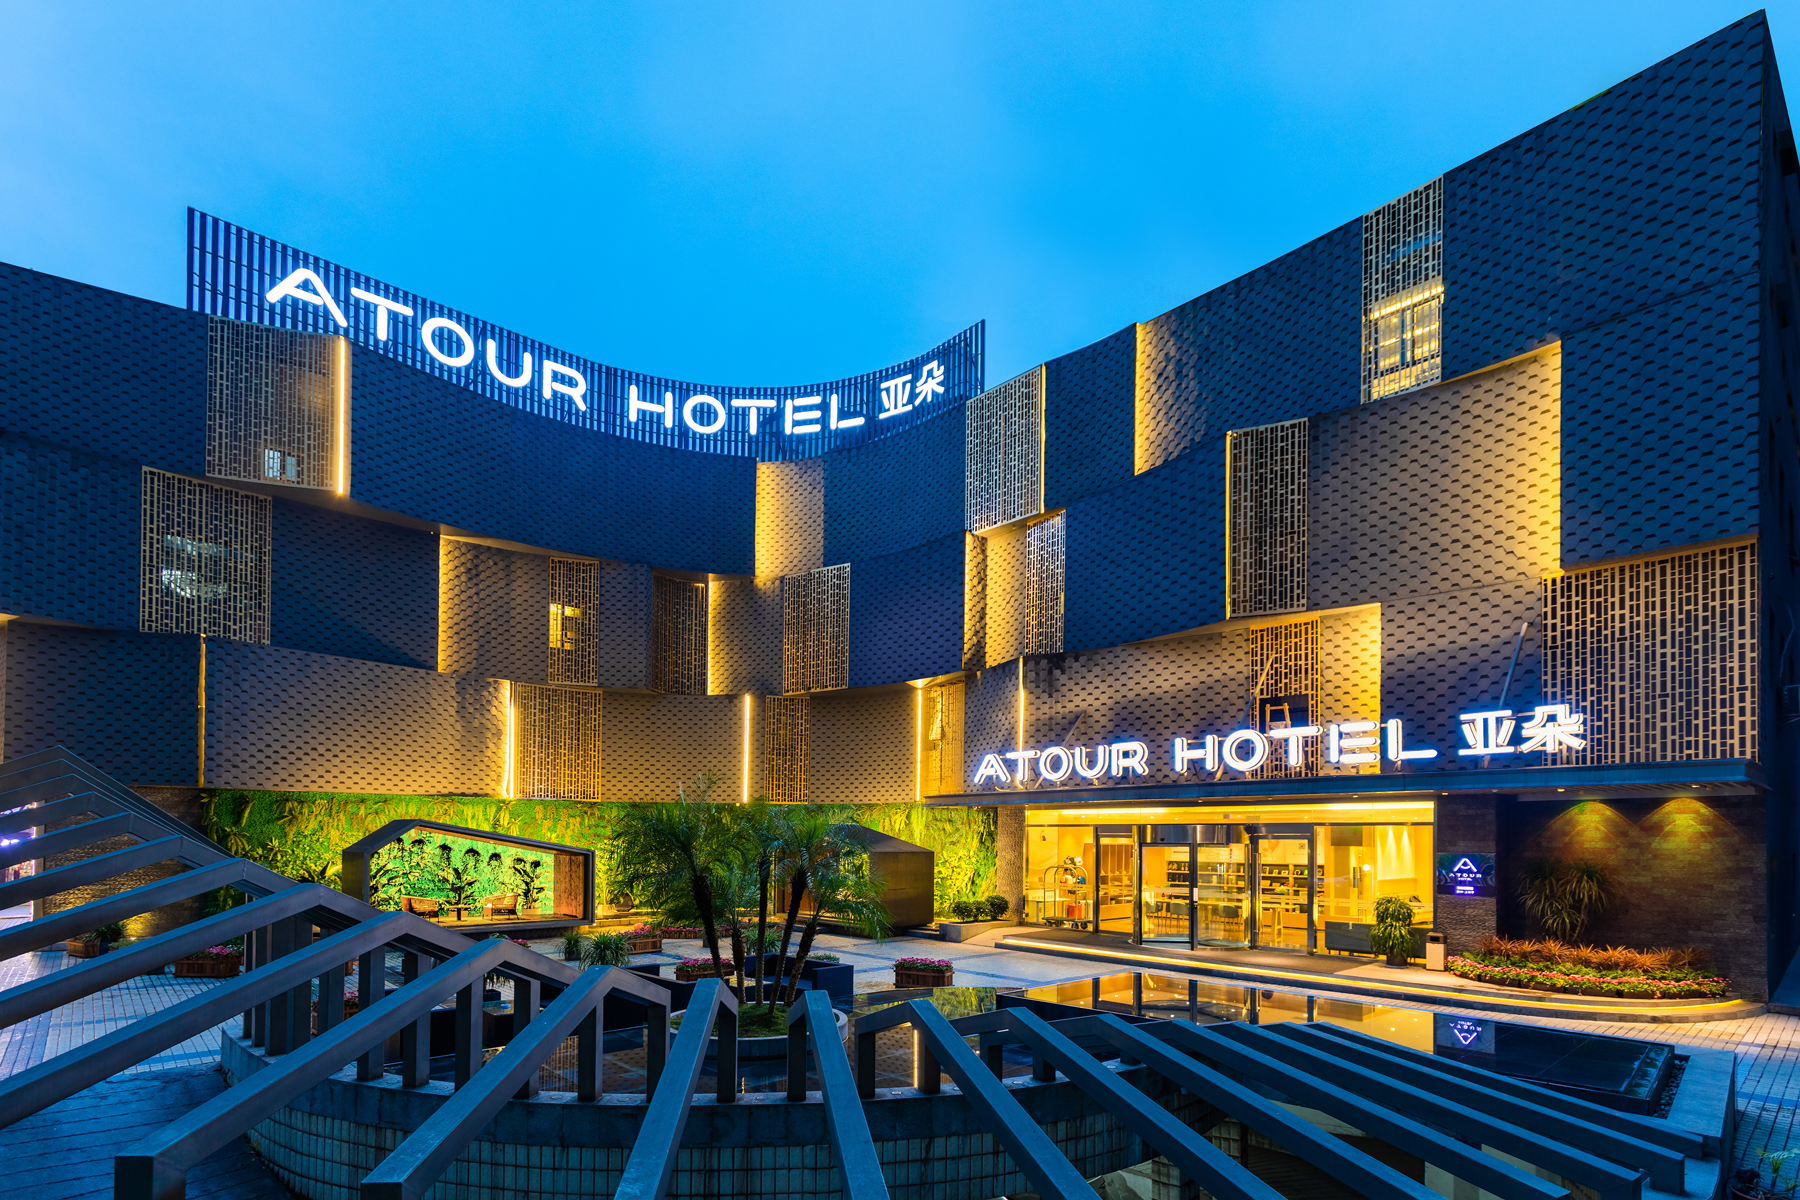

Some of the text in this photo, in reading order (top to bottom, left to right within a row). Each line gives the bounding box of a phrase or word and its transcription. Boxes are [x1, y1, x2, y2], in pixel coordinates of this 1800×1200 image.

[265, 268, 866, 436] ATOUR HOTEL
[879, 359, 946, 420] 亚朵
[973, 719, 1438, 785] ATOUR HOTEL
[1458, 703, 1587, 756] 亚朵
